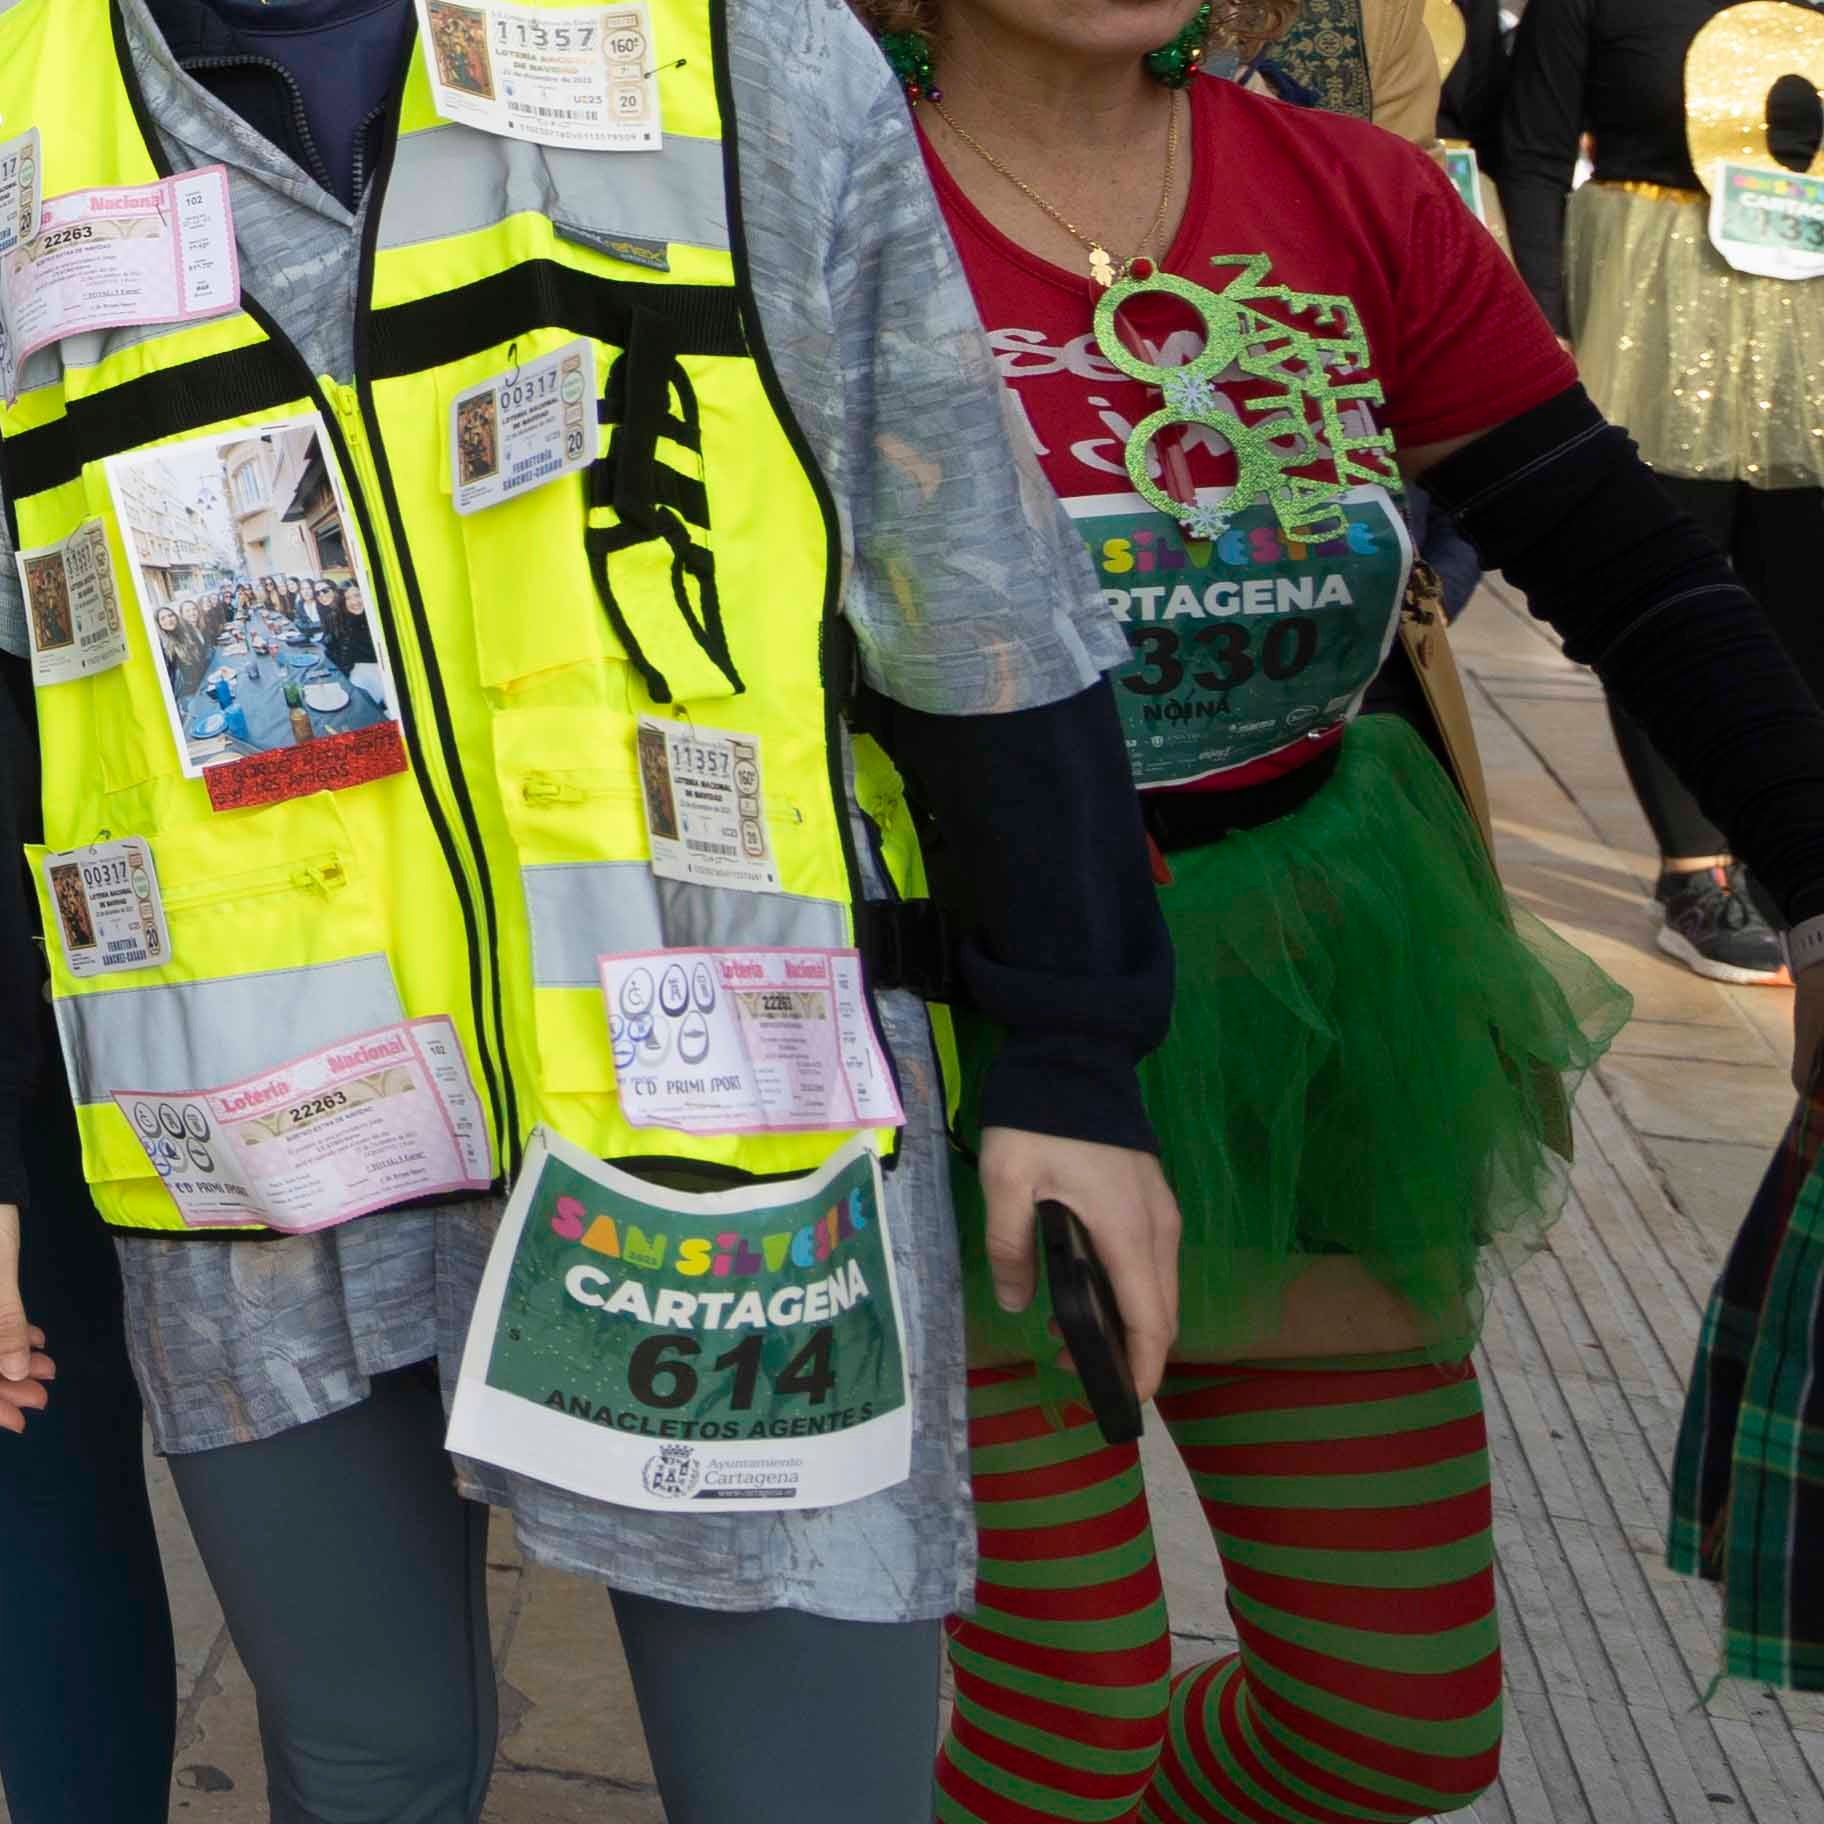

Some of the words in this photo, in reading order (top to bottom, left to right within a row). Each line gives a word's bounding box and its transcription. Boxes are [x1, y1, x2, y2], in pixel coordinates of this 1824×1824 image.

[497, 20, 595, 47] 11357
[620, 96, 637, 108] 20
[89, 188, 165, 211] Nacional
[185, 194, 203, 207] 102
[44, 225, 93, 249] 22263
[501, 371, 557, 409] 00317
[567, 431, 583, 453] 20
[1120, 616, 1318, 696] 330
[673, 744, 729, 773] 11357
[84, 862, 127, 885] 00317
[146, 928, 158, 948] 20
[666, 1078, 705, 1096] PRIMI
[289, 1090, 348, 1124] 22263
[551, 1195, 668, 1270] SAN
[565, 1258, 870, 1331] CARTAGENA
[627, 1327, 837, 1412] 614
[543, 1389, 742, 1440] ANACLETOS
[745, 1402, 874, 1439] AGENTES
[704, 1471, 800, 1488] Cartagena
